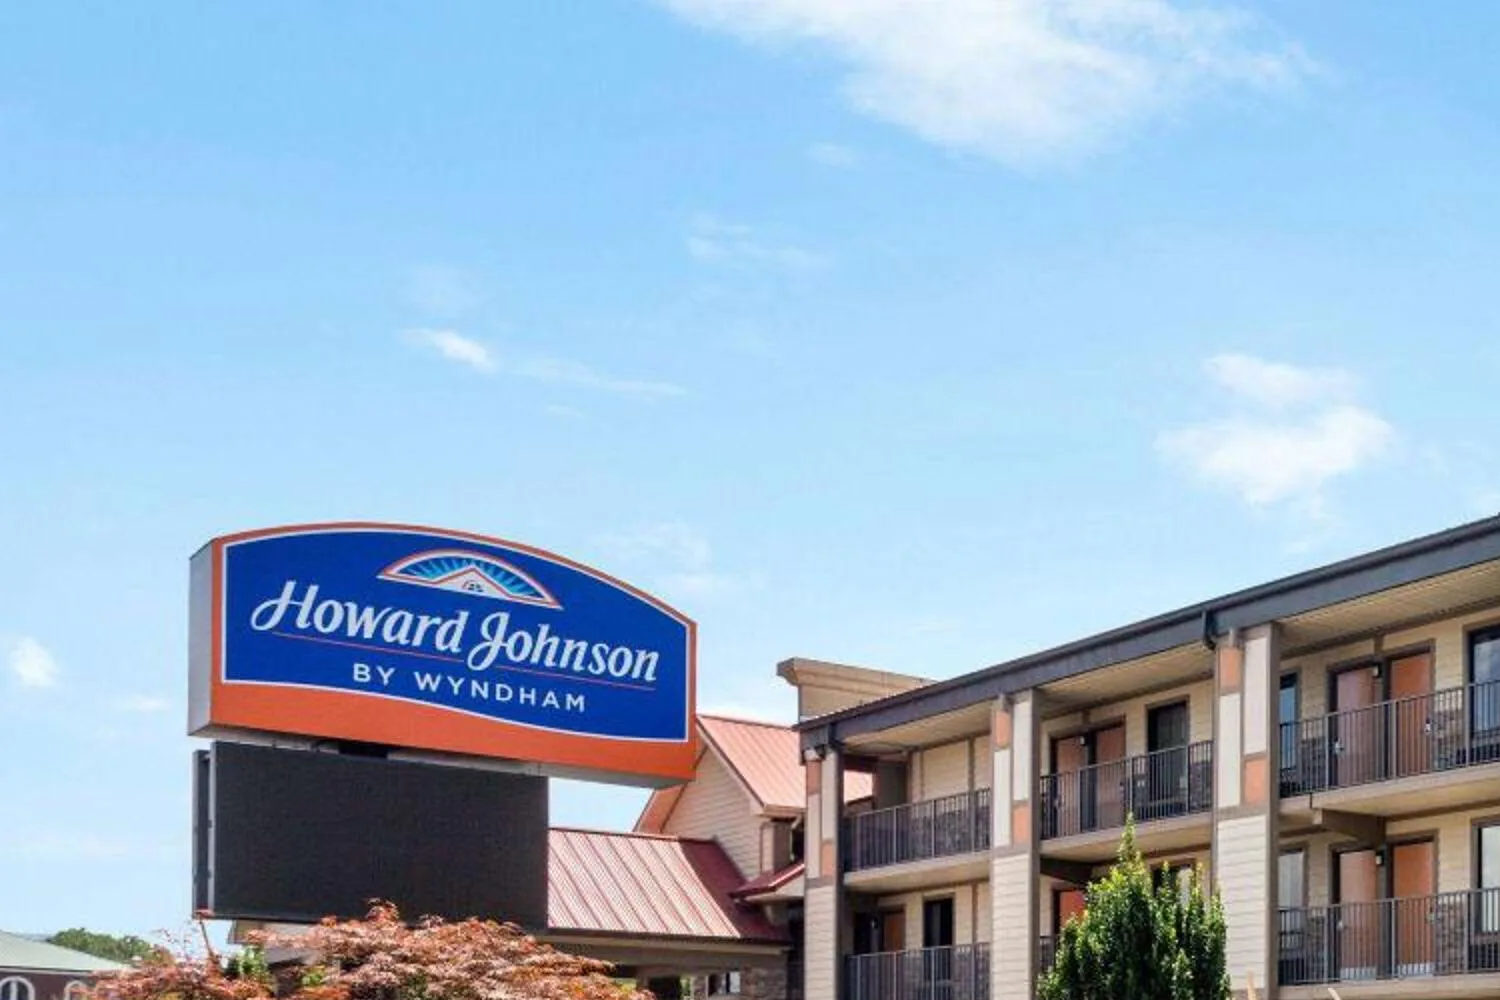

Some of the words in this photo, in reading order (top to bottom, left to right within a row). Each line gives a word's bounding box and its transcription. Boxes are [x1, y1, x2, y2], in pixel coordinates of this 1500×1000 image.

[251, 580, 468, 653] Howard
[467, 611, 660, 681] Johnson
[353, 663, 396, 686] BY
[414, 671, 586, 713] WYNDHAM
